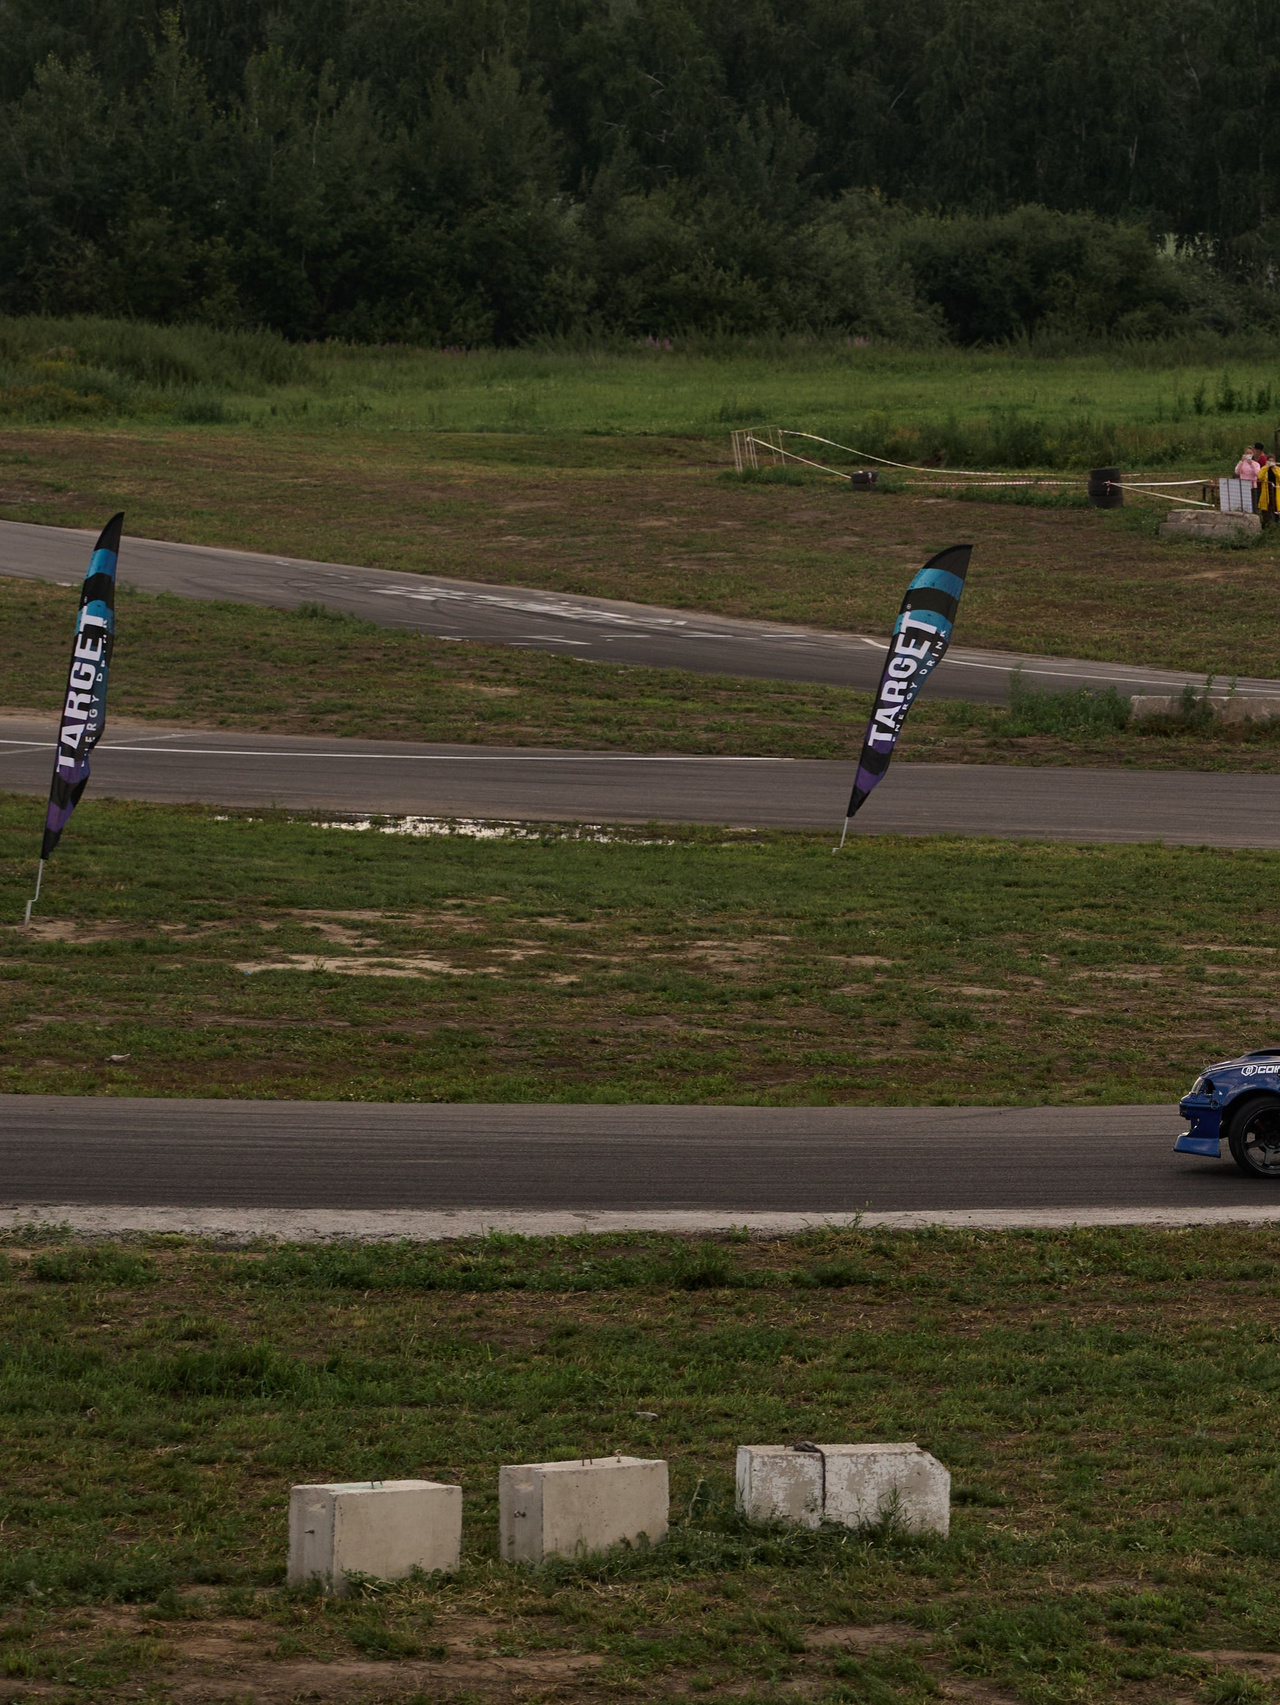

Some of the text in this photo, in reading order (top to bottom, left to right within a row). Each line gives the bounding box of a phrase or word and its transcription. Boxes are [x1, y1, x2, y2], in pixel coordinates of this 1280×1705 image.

[56, 605, 108, 772] TARGET
[868, 611, 938, 747] TARGET
[919, 629, 947, 675] DRINK
